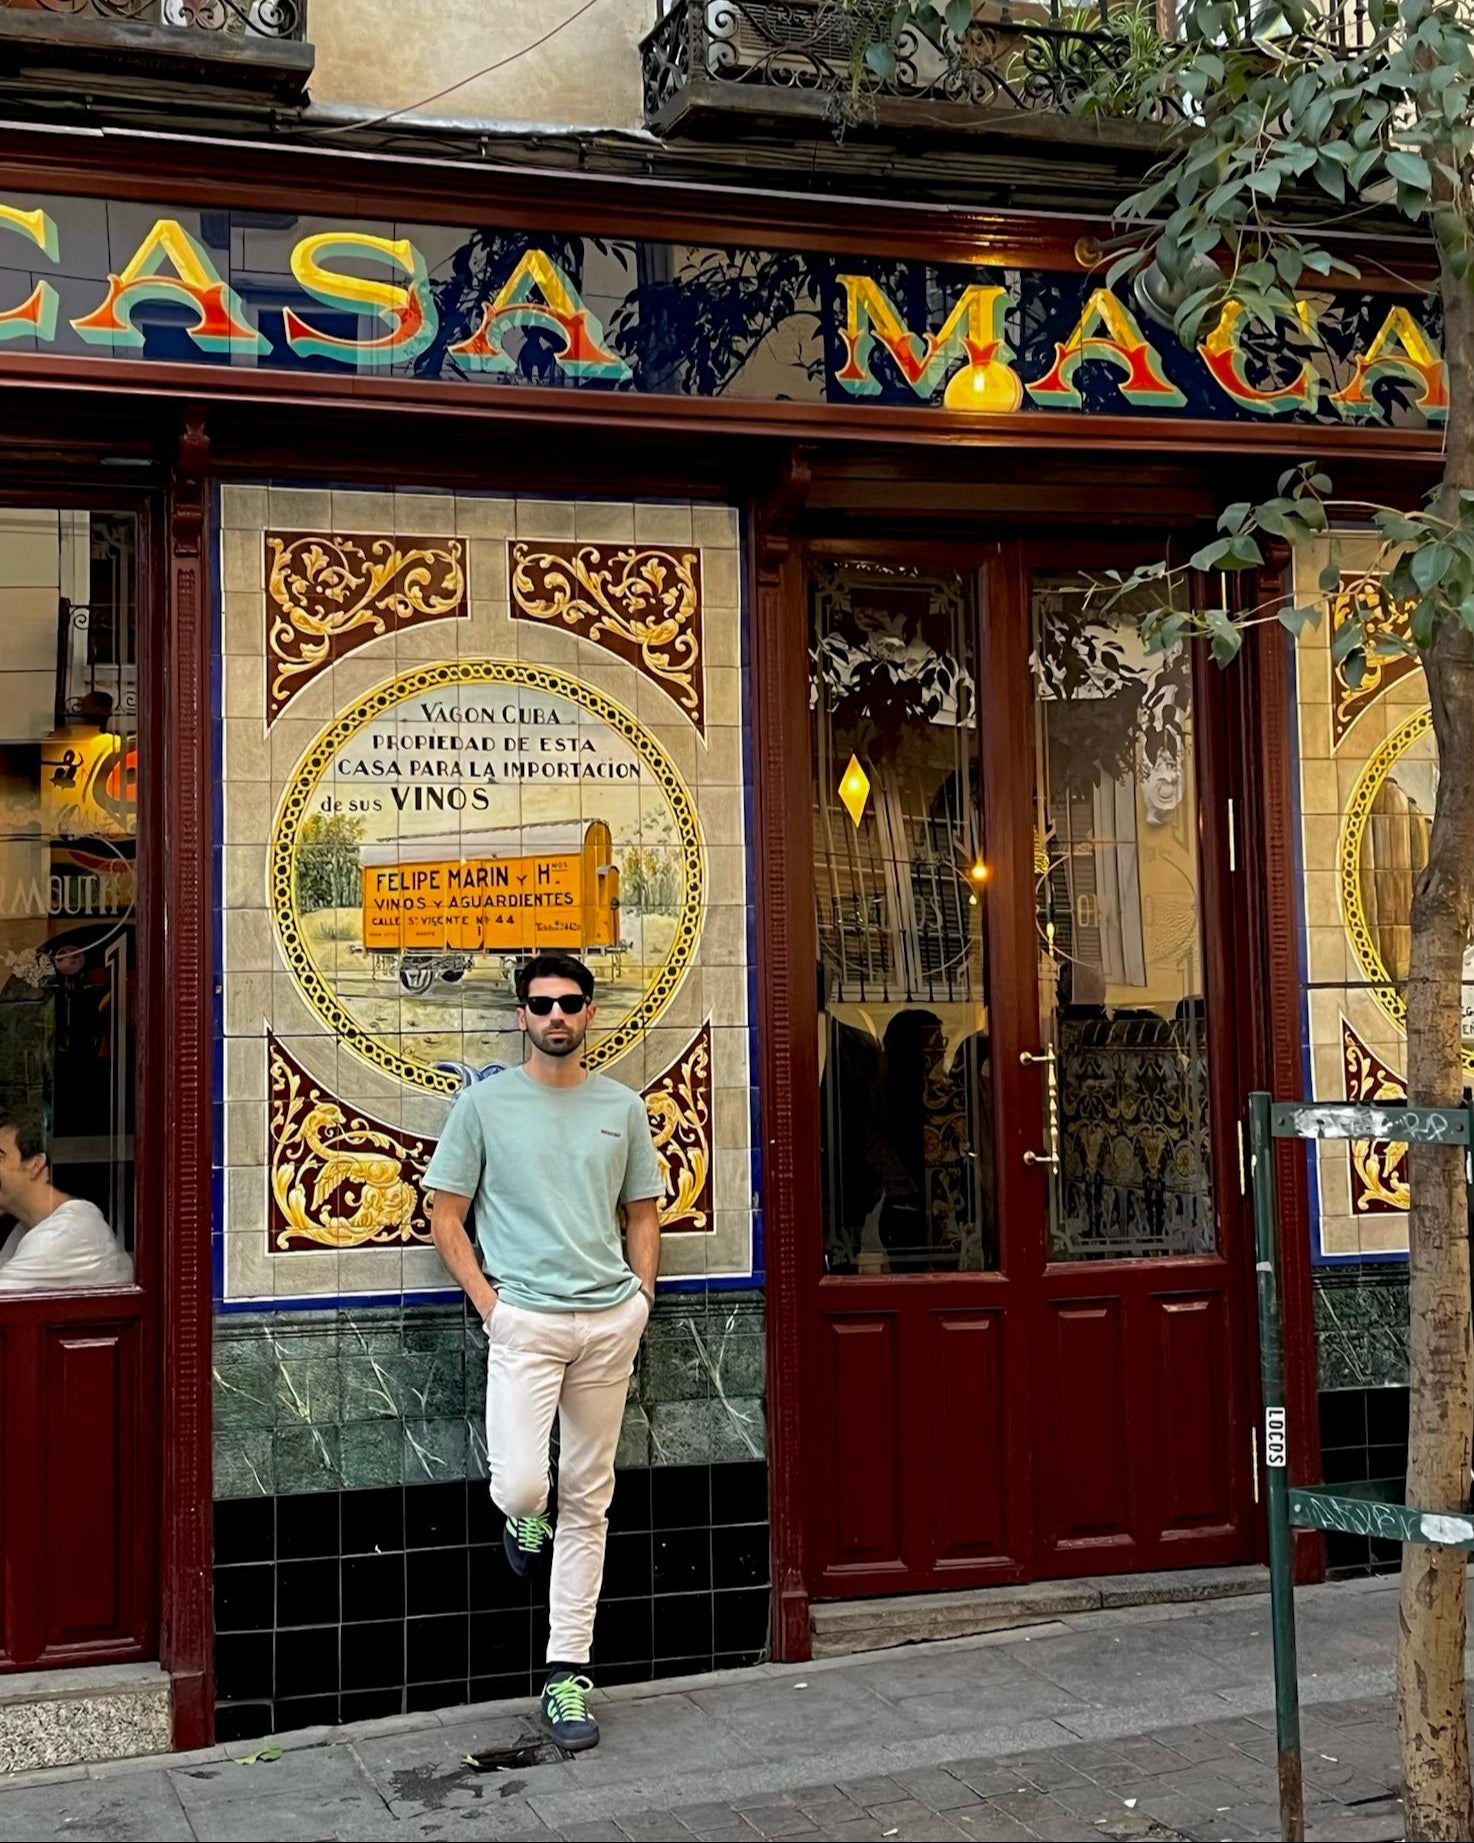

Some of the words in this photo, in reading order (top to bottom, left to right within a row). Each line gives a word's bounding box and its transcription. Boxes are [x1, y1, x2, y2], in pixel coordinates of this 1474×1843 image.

[421, 702, 495, 723] VAGON
[502, 705, 560, 725] CUBA
[373, 735, 496, 751] PROPIEDAD
[504, 737, 530, 752] DE
[540, 738, 596, 753] ESTA
[338, 759, 402, 777] CASA
[410, 760, 463, 777] PARA
[470, 762, 495, 778] LA
[504, 762, 641, 779] IMPORTACION
[321, 795, 343, 812] de
[349, 800, 382, 812] sus
[391, 786, 490, 811] VINOS
[377, 870, 440, 892] FELIPE
[448, 865, 508, 889] MARIN
[0, 875, 118, 915] MOUTH
[374, 896, 426, 911] VINOS
[449, 892, 574, 909] AGUARDIENTES
[372, 916, 401, 926] CALLE
[1268, 1410, 1284, 1463] LOCOS
